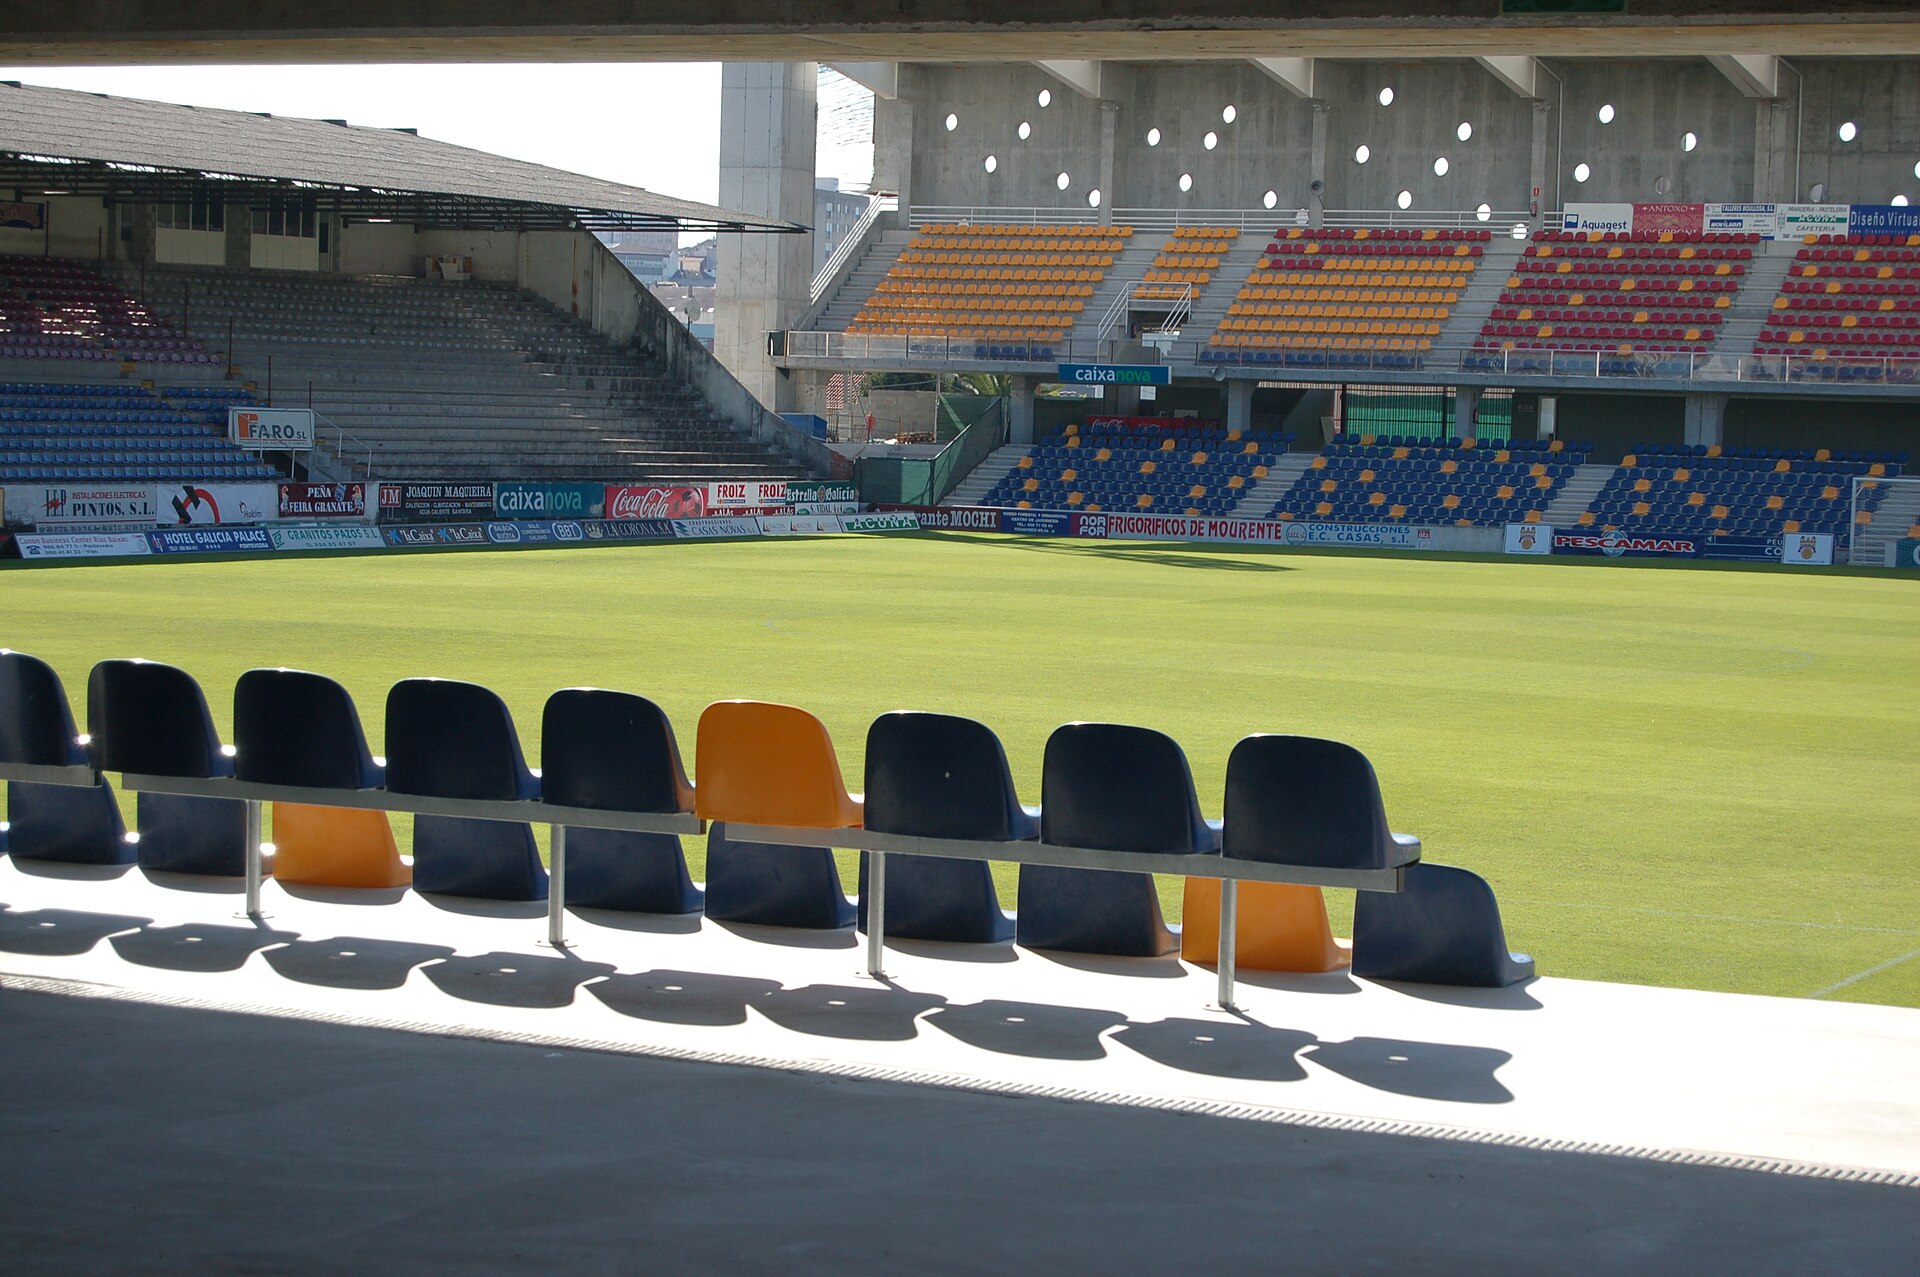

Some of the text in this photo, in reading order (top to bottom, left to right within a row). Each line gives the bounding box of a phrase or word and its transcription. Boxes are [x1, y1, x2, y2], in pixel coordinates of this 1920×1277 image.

[1581, 220, 1627, 231] Aquagest
[1850, 211, 1885, 226] Diseño
[1075, 365, 1150, 383] caixanova
[249, 424, 307, 439] FARO SL
[72, 490, 147, 499] INSTALACIONES ELECTRICAS
[307, 484, 332, 498] PEÑA
[381, 489, 400, 505] JM
[406, 486, 492, 498] JOAQUIN MAQUIEIRA
[717, 484, 746, 498] FROIZ
[758, 484, 786, 498] FROIZ
[787, 486, 855, 502] Estrella Galicia
[500, 486, 582, 511] caixanova
[129, 502, 155, 516] S.L.
[289, 501, 354, 513] FEIRA GRANATE
[853, 514, 912, 529] ACUÑA
[950, 510, 997, 528] MOCHI
[1079, 515, 1106, 526] NOR
[287, 529, 333, 541] GRANITOS
[334, 528, 364, 540] PAZOS
[557, 524, 578, 538] BBT
[604, 523, 618, 537] LA
[691, 525, 719, 536] CASAS
[719, 524, 747, 535] NOVAS
[1079, 525, 1106, 536] FOR
[1109, 515, 1282, 540] FRIGORIFICOS DE MOURENTE
[1308, 523, 1410, 534] CONSTRUCCIONES
[71, 536, 92, 544] Center
[163, 529, 267, 545] HOTEL GALICIA PALACE
[1308, 531, 1330, 541] E.C.
[1554, 535, 1696, 552] PESCAMAR
